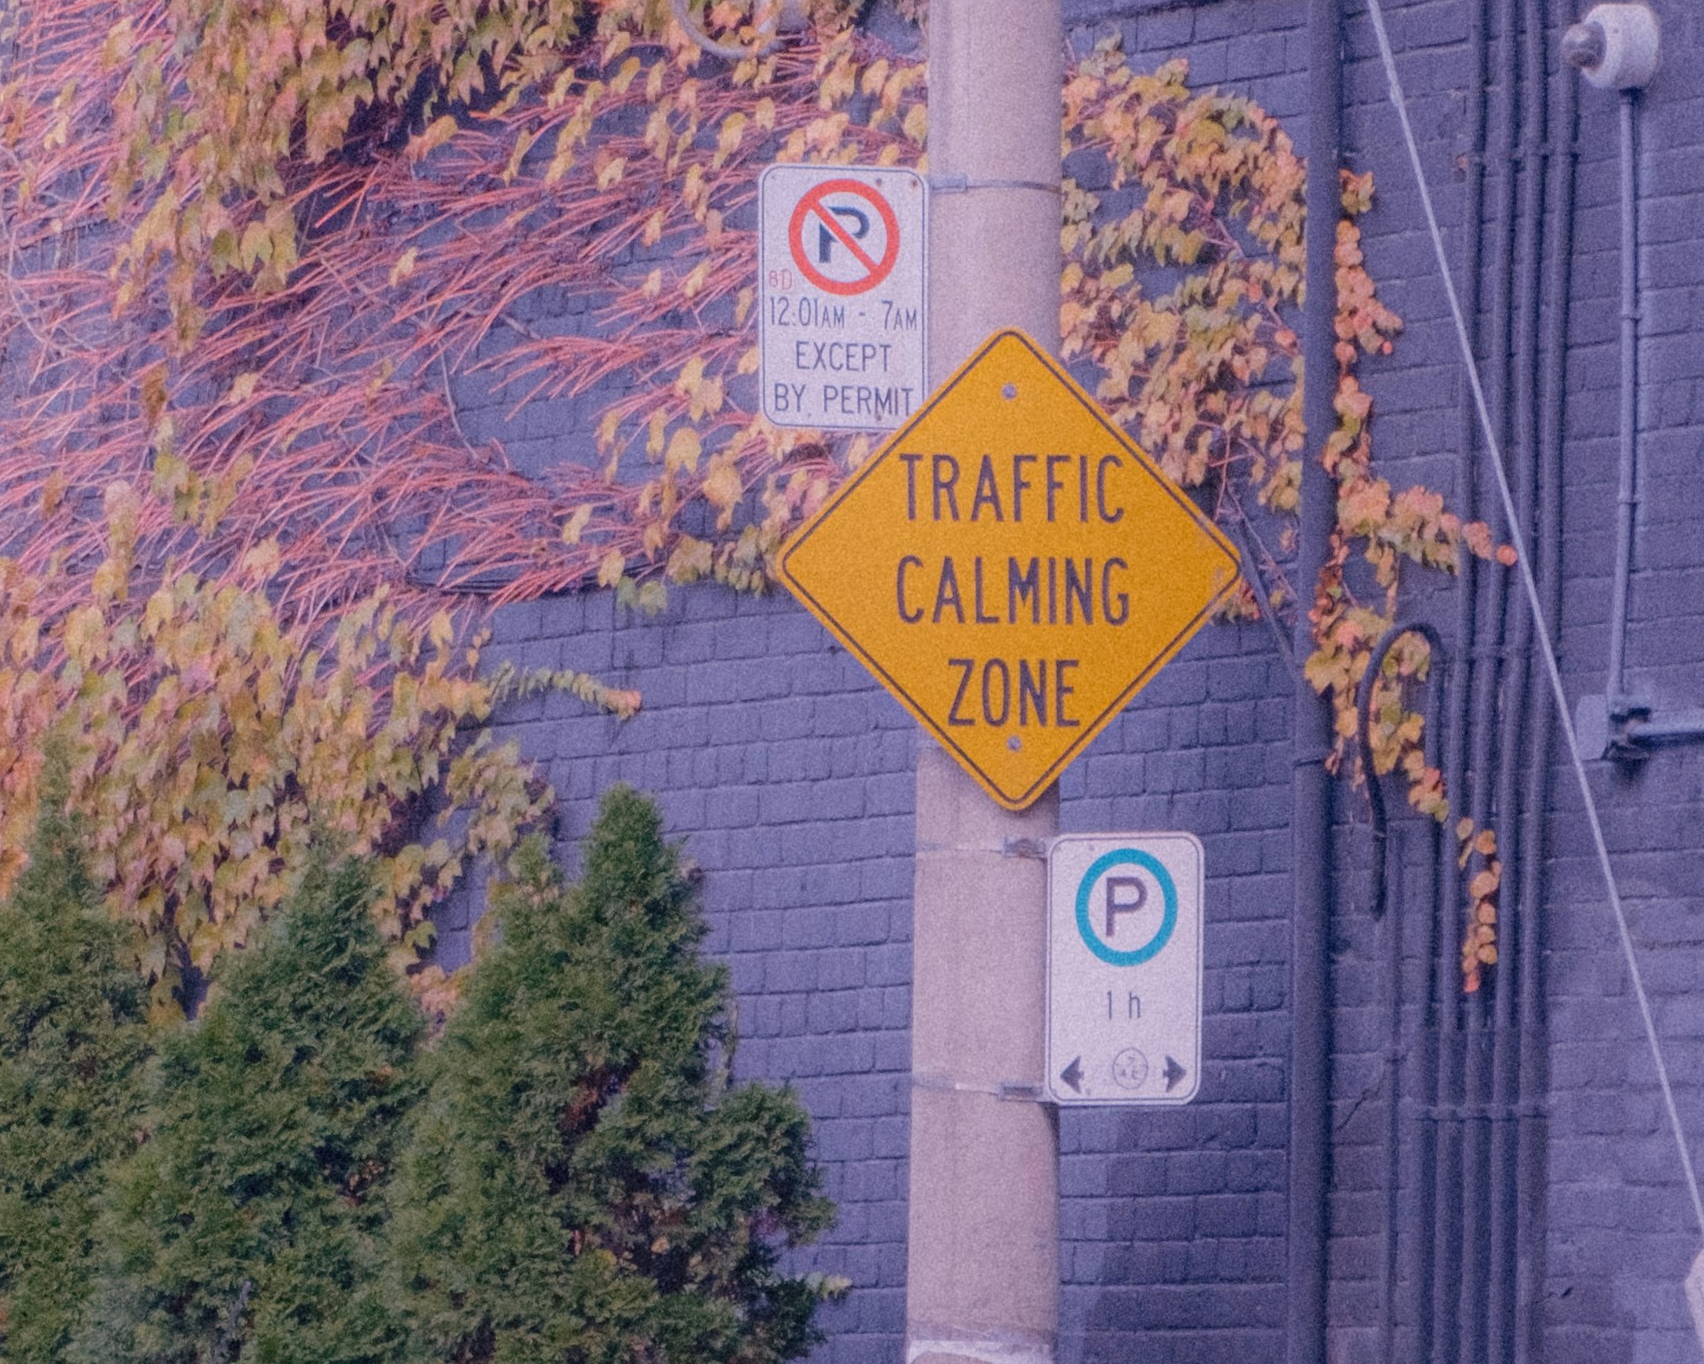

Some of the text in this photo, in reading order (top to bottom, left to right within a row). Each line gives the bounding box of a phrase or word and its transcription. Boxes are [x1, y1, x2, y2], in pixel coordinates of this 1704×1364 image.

[770, 296, 845, 328] 12:01AM
[881, 299, 918, 332] 7AM
[796, 340, 892, 373] EXCEPT
[774, 383, 914, 416] BY PERMIT
[899, 453, 1125, 525] TRAFFIC
[896, 555, 1130, 628] CALMING
[948, 658, 1081, 728] ZONE
[1105, 877, 1148, 937] P
